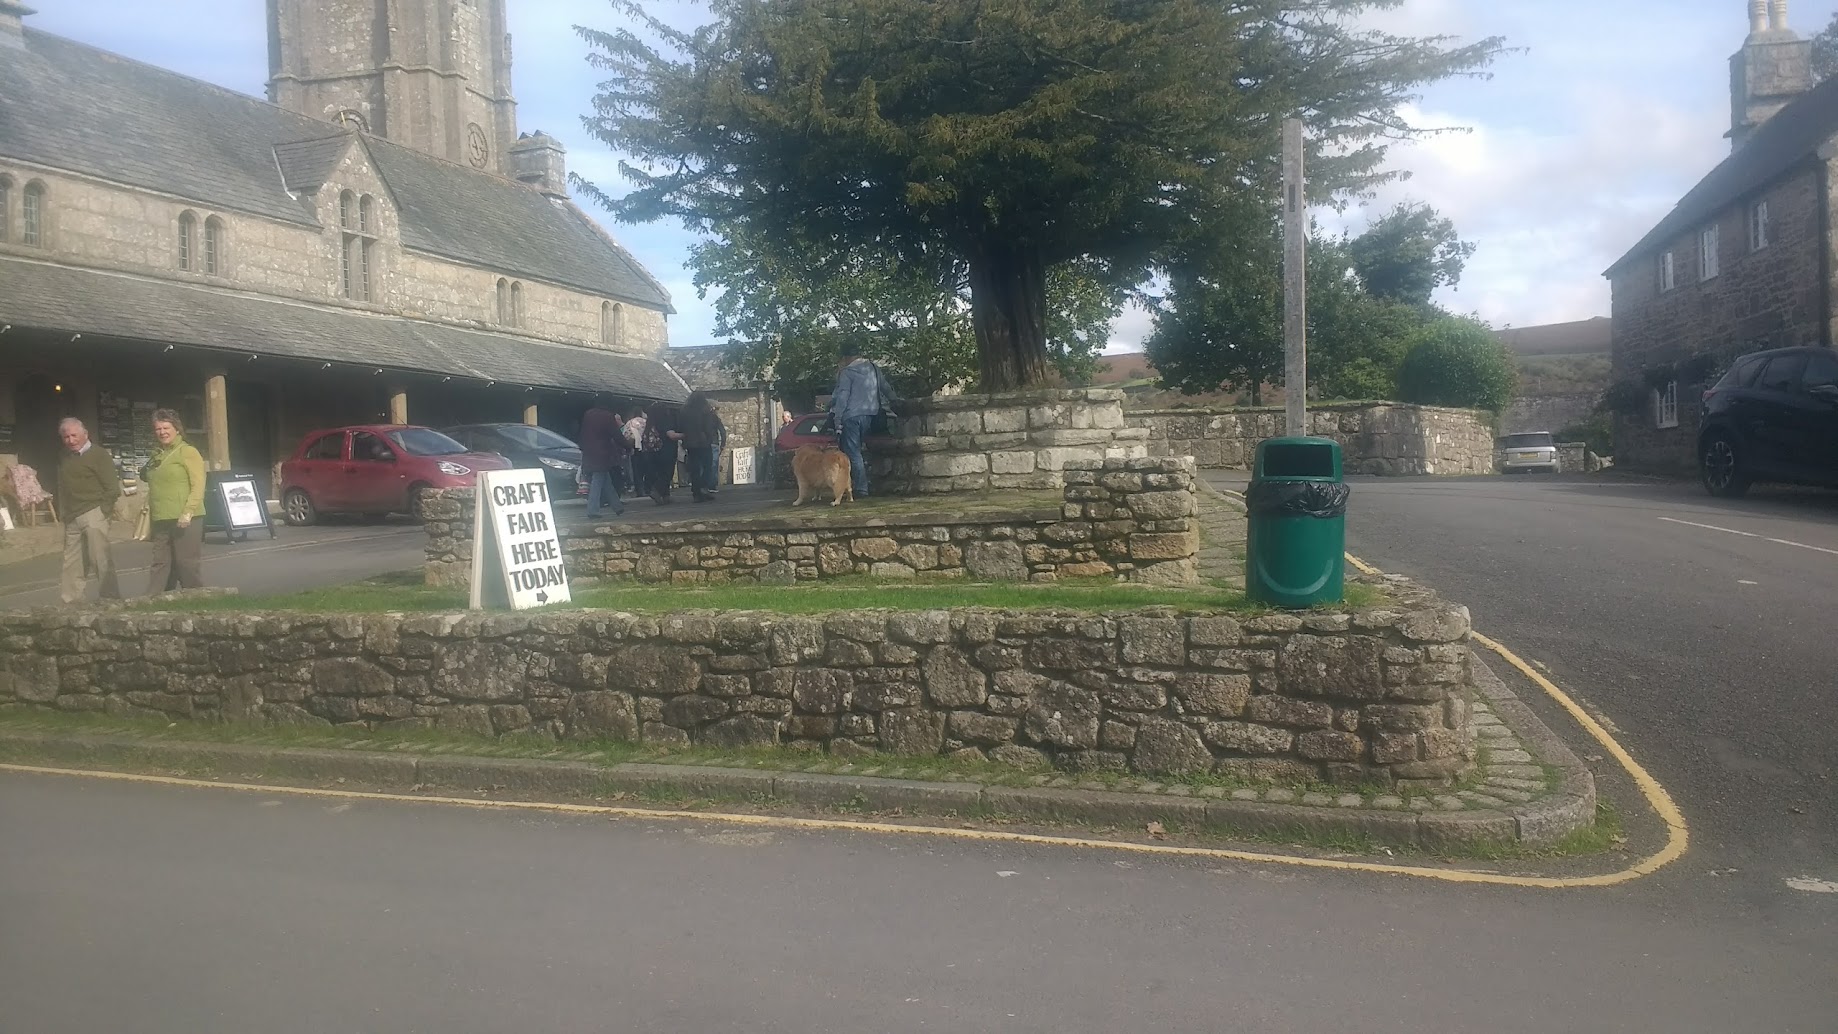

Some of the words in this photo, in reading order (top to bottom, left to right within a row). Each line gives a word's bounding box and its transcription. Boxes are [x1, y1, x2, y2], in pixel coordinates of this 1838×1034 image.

[493, 482, 547, 506] CRAFT
[507, 512, 549, 535] FAIR
[511, 539, 558, 565] HERE
[509, 564, 564, 592] TODAY
